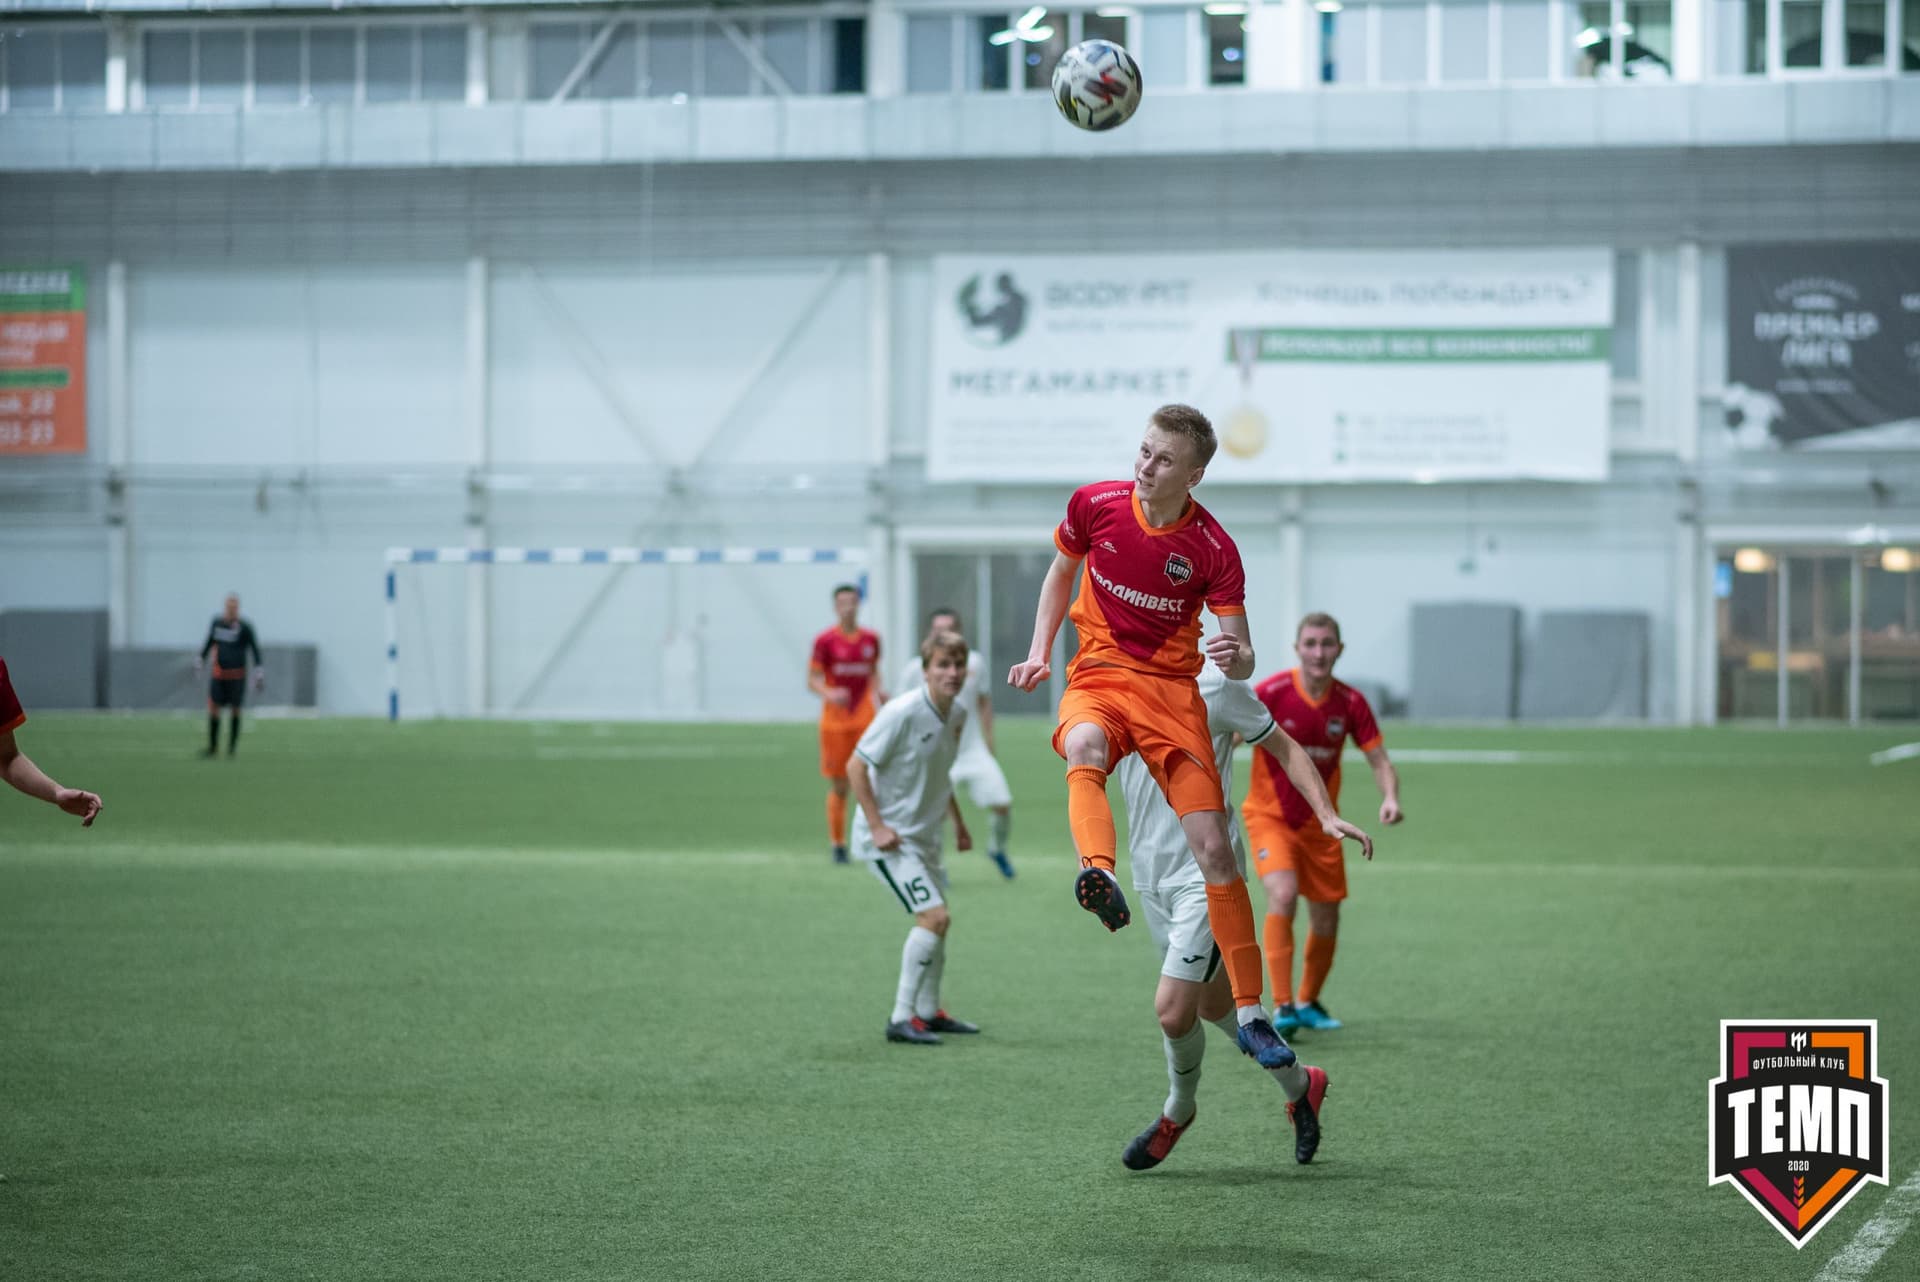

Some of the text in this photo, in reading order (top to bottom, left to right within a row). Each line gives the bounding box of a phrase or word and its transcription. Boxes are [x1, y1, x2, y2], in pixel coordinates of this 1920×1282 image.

[1754, 312, 1878, 339] ПРЕМЬЕР
[1781, 340, 1851, 368] ЛИГА
[949, 367, 1191, 397] МЕГАМАРКЕТ
[1168, 561, 1190, 580] ТЕМП
[904, 877, 931, 905] 15
